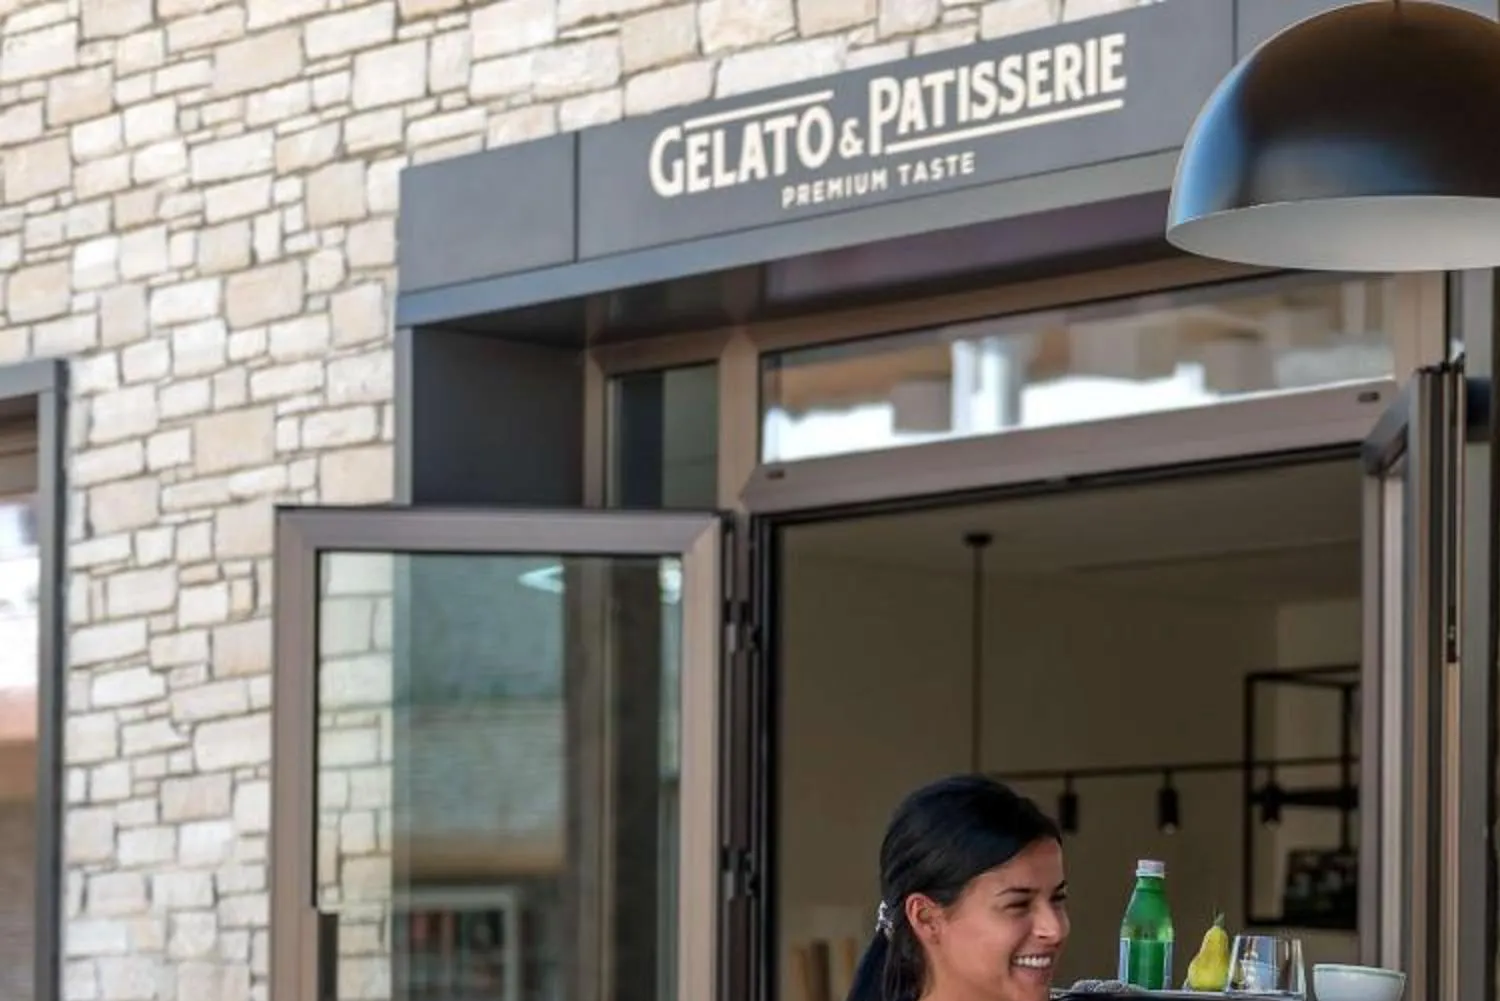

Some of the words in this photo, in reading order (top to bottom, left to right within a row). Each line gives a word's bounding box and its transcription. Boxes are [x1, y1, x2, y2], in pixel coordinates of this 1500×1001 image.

[649, 104, 834, 197] GELATO
[839, 117, 863, 158] &
[869, 33, 1126, 155] PATISSERIE
[781, 168, 888, 208] PREMIUM
[899, 152, 976, 185] TASTE
